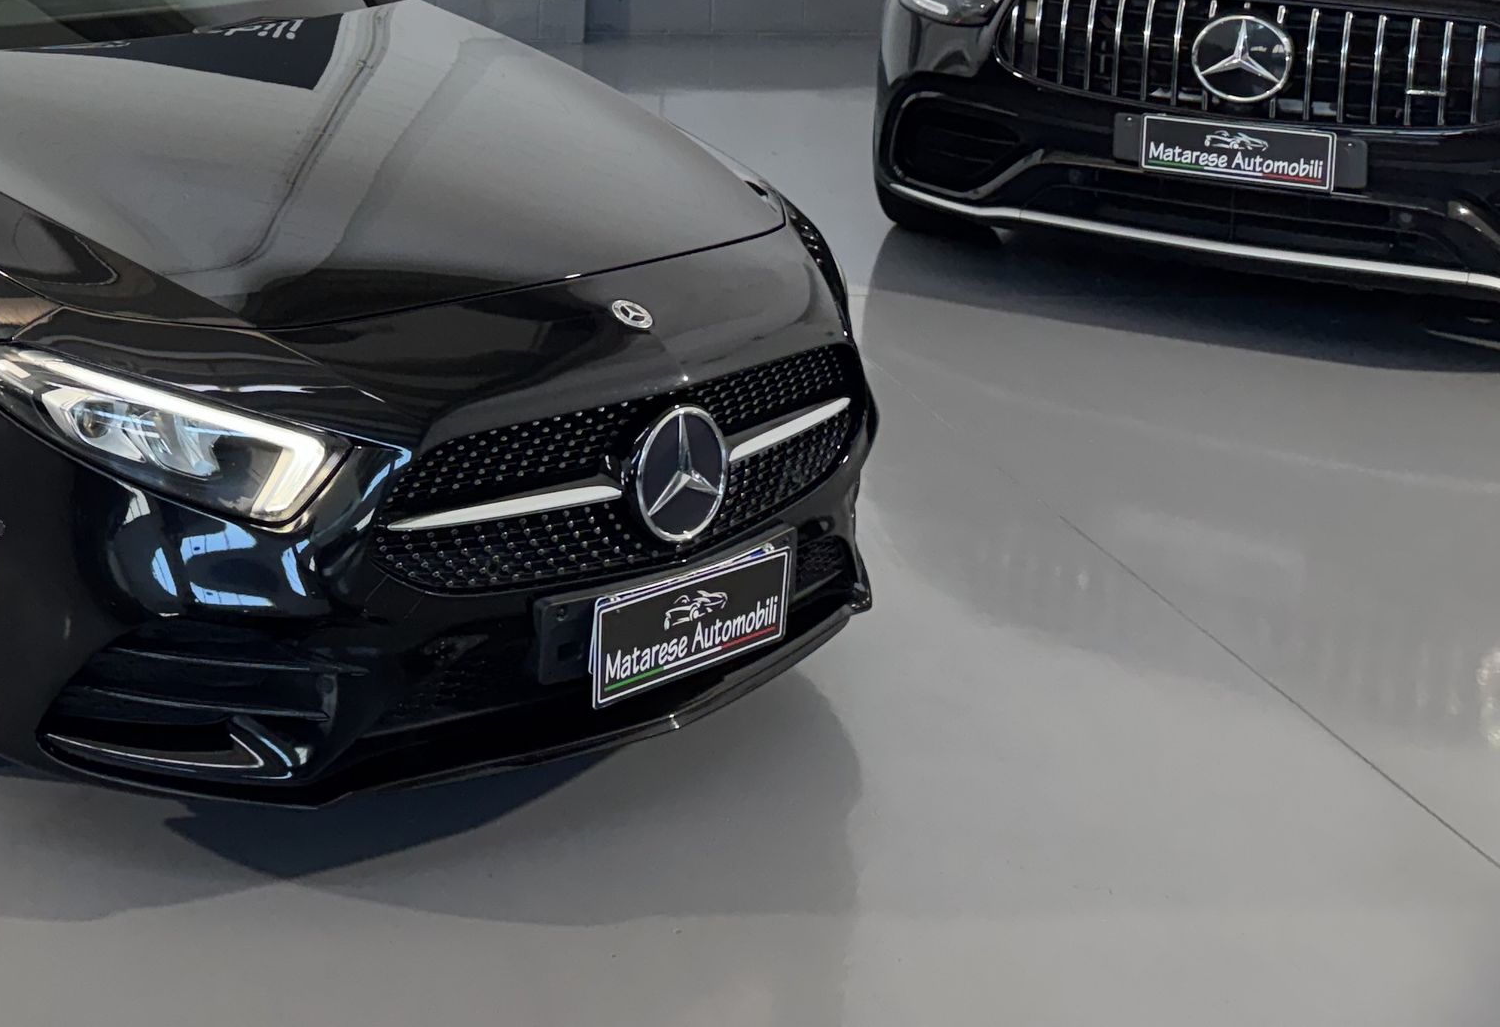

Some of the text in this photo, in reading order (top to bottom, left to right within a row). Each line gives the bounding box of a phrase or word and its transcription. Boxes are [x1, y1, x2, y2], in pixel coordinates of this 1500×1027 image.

[1149, 140, 1324, 179] Matarese Automobili
[605, 595, 779, 684] Matarese Automobili
